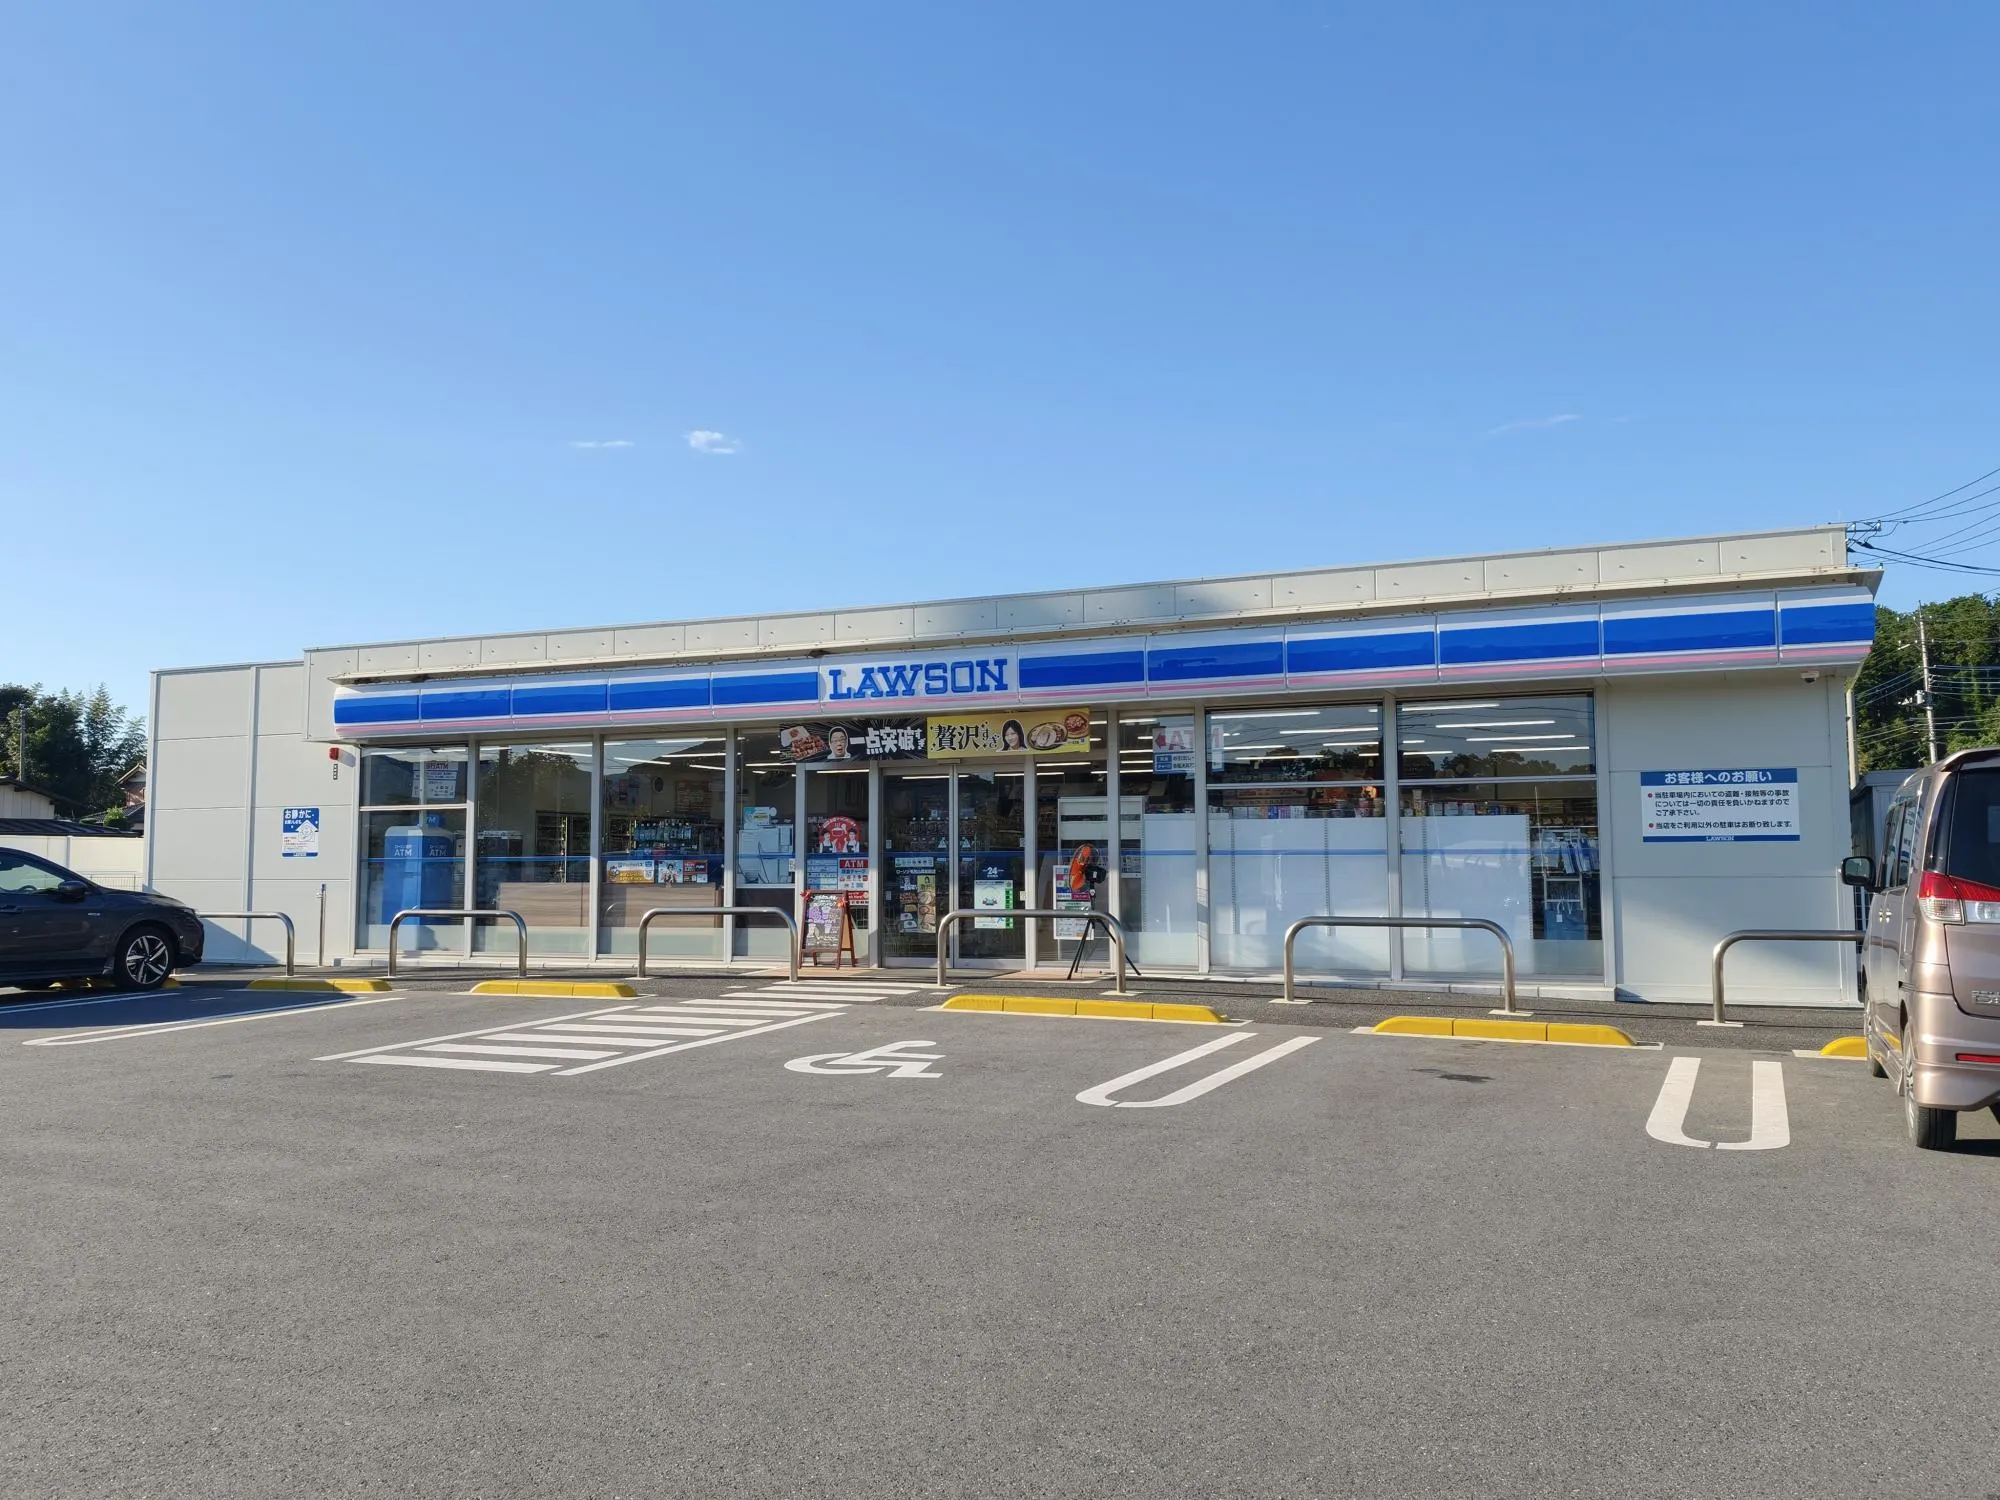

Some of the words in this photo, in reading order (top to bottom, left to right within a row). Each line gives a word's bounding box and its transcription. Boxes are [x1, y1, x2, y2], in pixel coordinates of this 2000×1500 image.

[828, 658, 1009, 700] LAWSON
[1664, 770, 1773, 784] お客様へのお願い
[1655, 798, 1790, 807] については一切の責任を負いかねますので
[394, 849, 413, 857] ATM
[429, 849, 449, 857] ATM
[844, 860, 865, 868] ATM
[987, 866, 998, 875] 24
